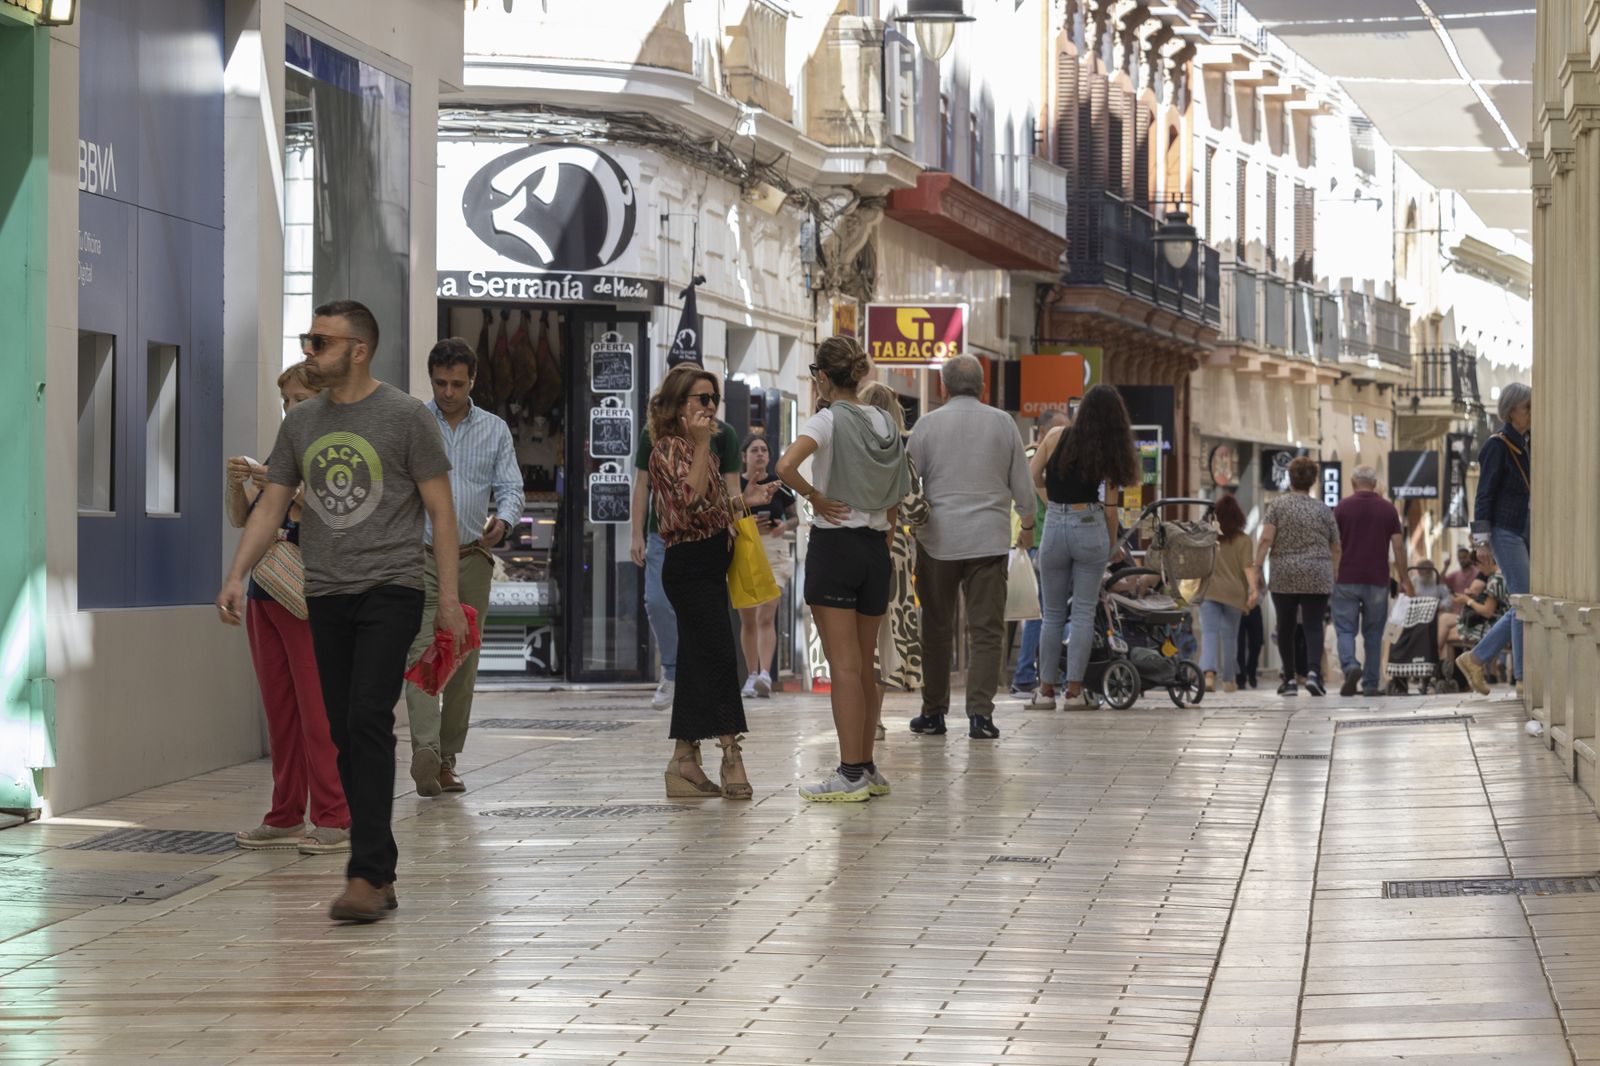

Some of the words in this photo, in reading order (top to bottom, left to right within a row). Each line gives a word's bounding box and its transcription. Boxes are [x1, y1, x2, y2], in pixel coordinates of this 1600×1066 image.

[79, 140, 116, 194] BBVA
[467, 270, 584, 300] Serranía
[593, 277, 612, 294] de
[593, 343, 631, 351] OFERTA
[872, 341, 958, 358] TABACOS
[592, 409, 631, 417] OFERTA
[1023, 402, 1068, 413] orang
[317, 448, 362, 468] JACK
[591, 474, 630, 482] OFERTA
[317, 487, 366, 513] JONES
